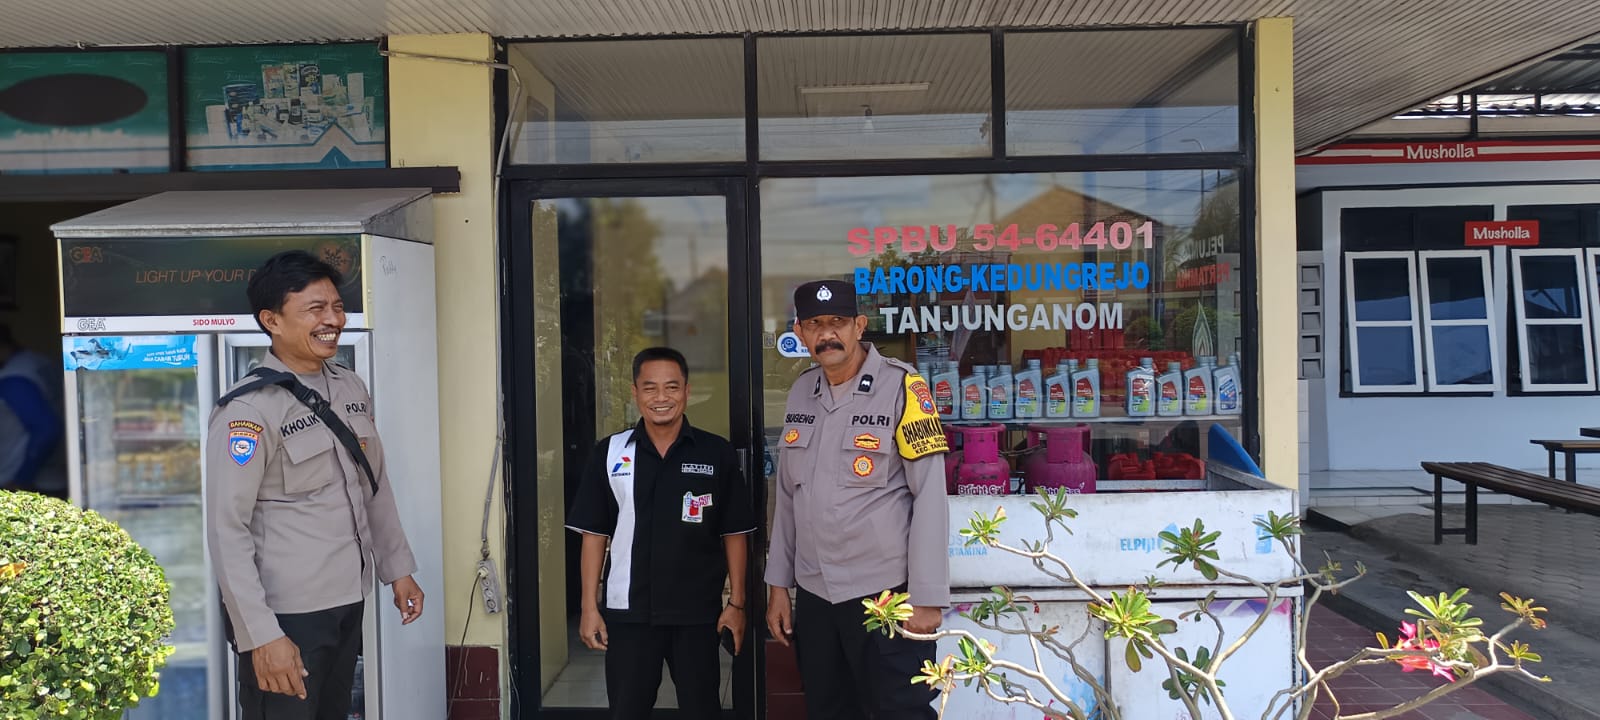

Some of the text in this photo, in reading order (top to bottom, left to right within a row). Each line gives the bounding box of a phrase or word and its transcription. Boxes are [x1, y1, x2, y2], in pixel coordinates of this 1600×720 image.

[1406, 143, 1475, 160] Musholla
[846, 220, 1154, 256] SPBU 54-64401
[1473, 226, 1531, 240] Musholla
[69, 246, 103, 264] GEA
[135, 269, 177, 284] LIGHT
[181, 269, 200, 284] UP
[205, 268, 244, 283] YOUR
[854, 259, 1150, 296] BARONG-KEDUNGREJO
[77, 318, 106, 331] GEA
[192, 318, 235, 327] SIDO MULYO
[879, 302, 1125, 335] TANJUNGANOM
[280, 413, 321, 438] KHOLIK
[785, 413, 816, 425] SUGENG
[851, 414, 890, 427] POLRI
[957, 483, 987, 496] Bright
